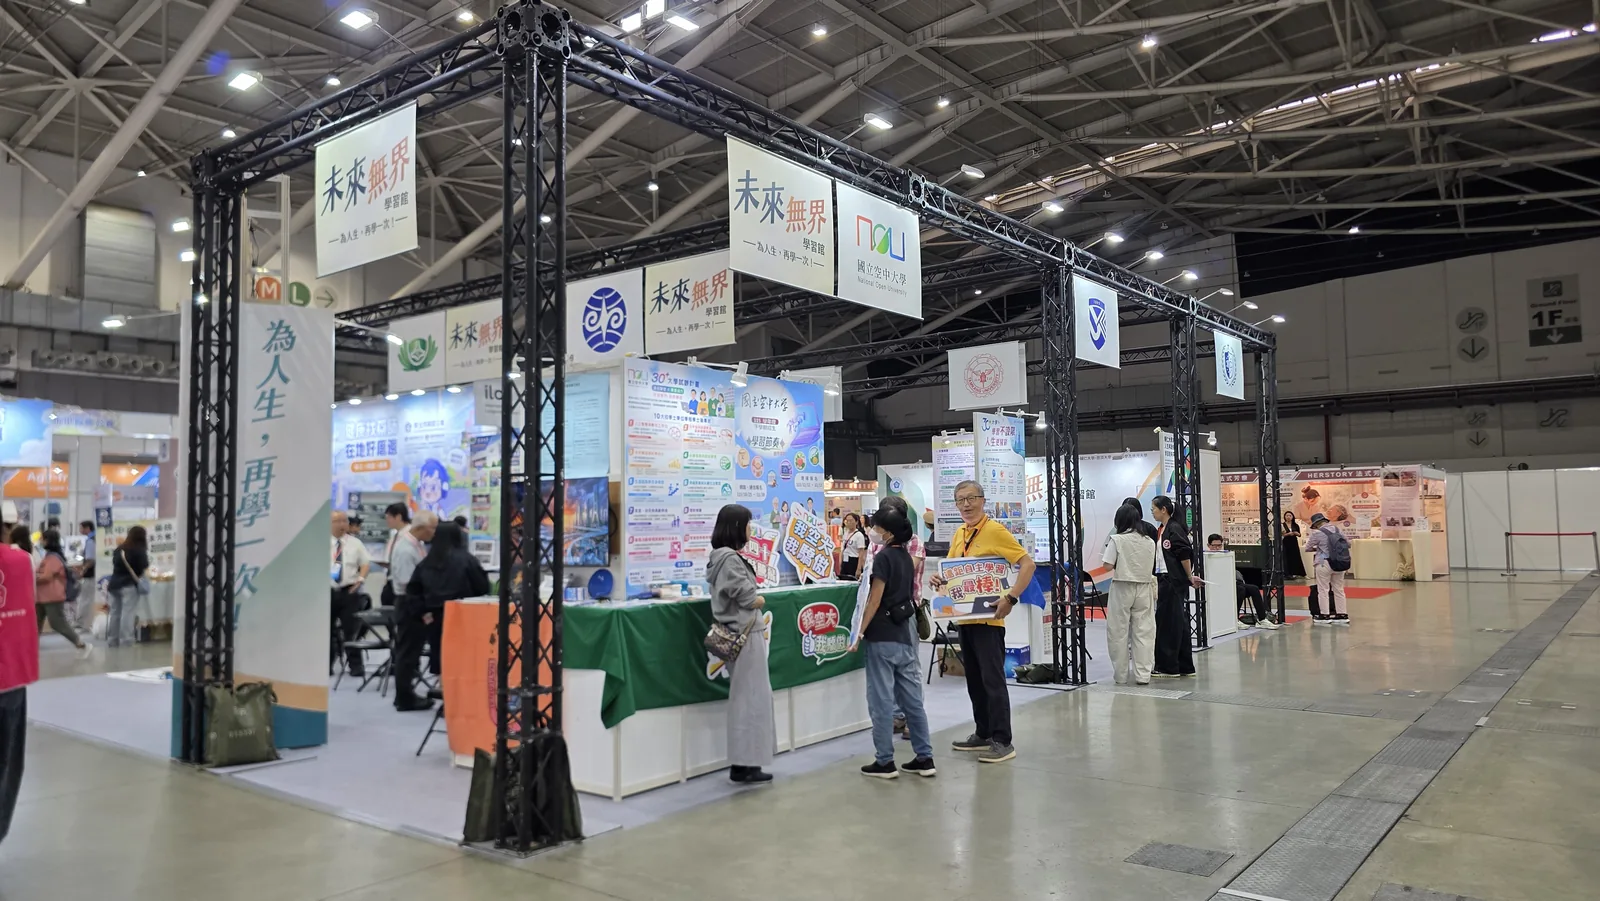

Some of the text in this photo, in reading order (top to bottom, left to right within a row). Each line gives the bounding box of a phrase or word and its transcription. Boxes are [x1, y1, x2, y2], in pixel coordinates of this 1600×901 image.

[321, 136, 409, 216] 未來無界
[384, 191, 409, 211] 學習館
[733, 169, 827, 235] 未來無界
[802, 237, 825, 256] 學習館
[857, 258, 907, 286] 國立空中大學
[260, 283, 303, 303] M L
[650, 268, 728, 315] 未來無界
[857, 277, 908, 298] National Open University
[705, 304, 727, 316] 學習館
[1532, 309, 1563, 327] 1F
[450, 314, 503, 351] 未來無界
[1307, 471, 1353, 479] HERSTORY
[793, 519, 834, 557] 我空大
[785, 536, 830, 578] 我驕傲
[944, 562, 1006, 579] 遠距自主學習
[801, 608, 837, 632] 我空大
